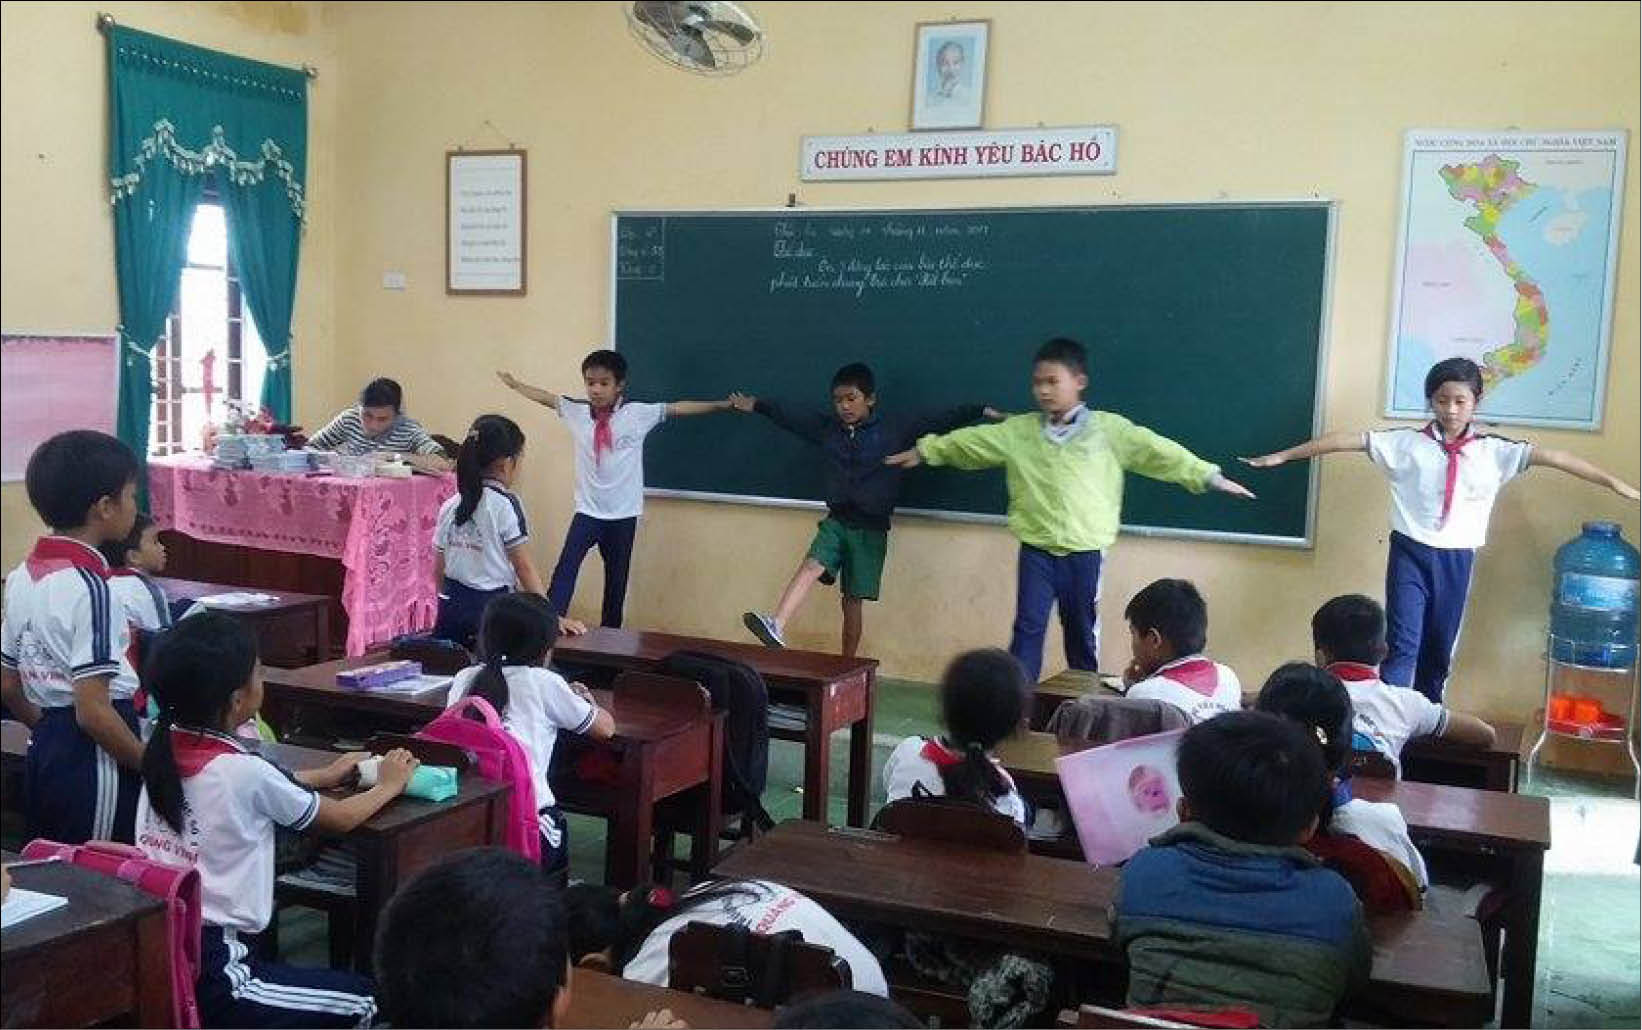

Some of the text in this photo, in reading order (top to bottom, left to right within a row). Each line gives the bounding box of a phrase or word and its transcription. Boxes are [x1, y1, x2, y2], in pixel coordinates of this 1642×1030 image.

[814, 146, 878, 169] CHÚNG
[884, 149, 913, 168] EM
[919, 144, 968, 166] KÍNH
[975, 142, 1015, 165] YÊU
[1020, 139, 1062, 163] BÁC
